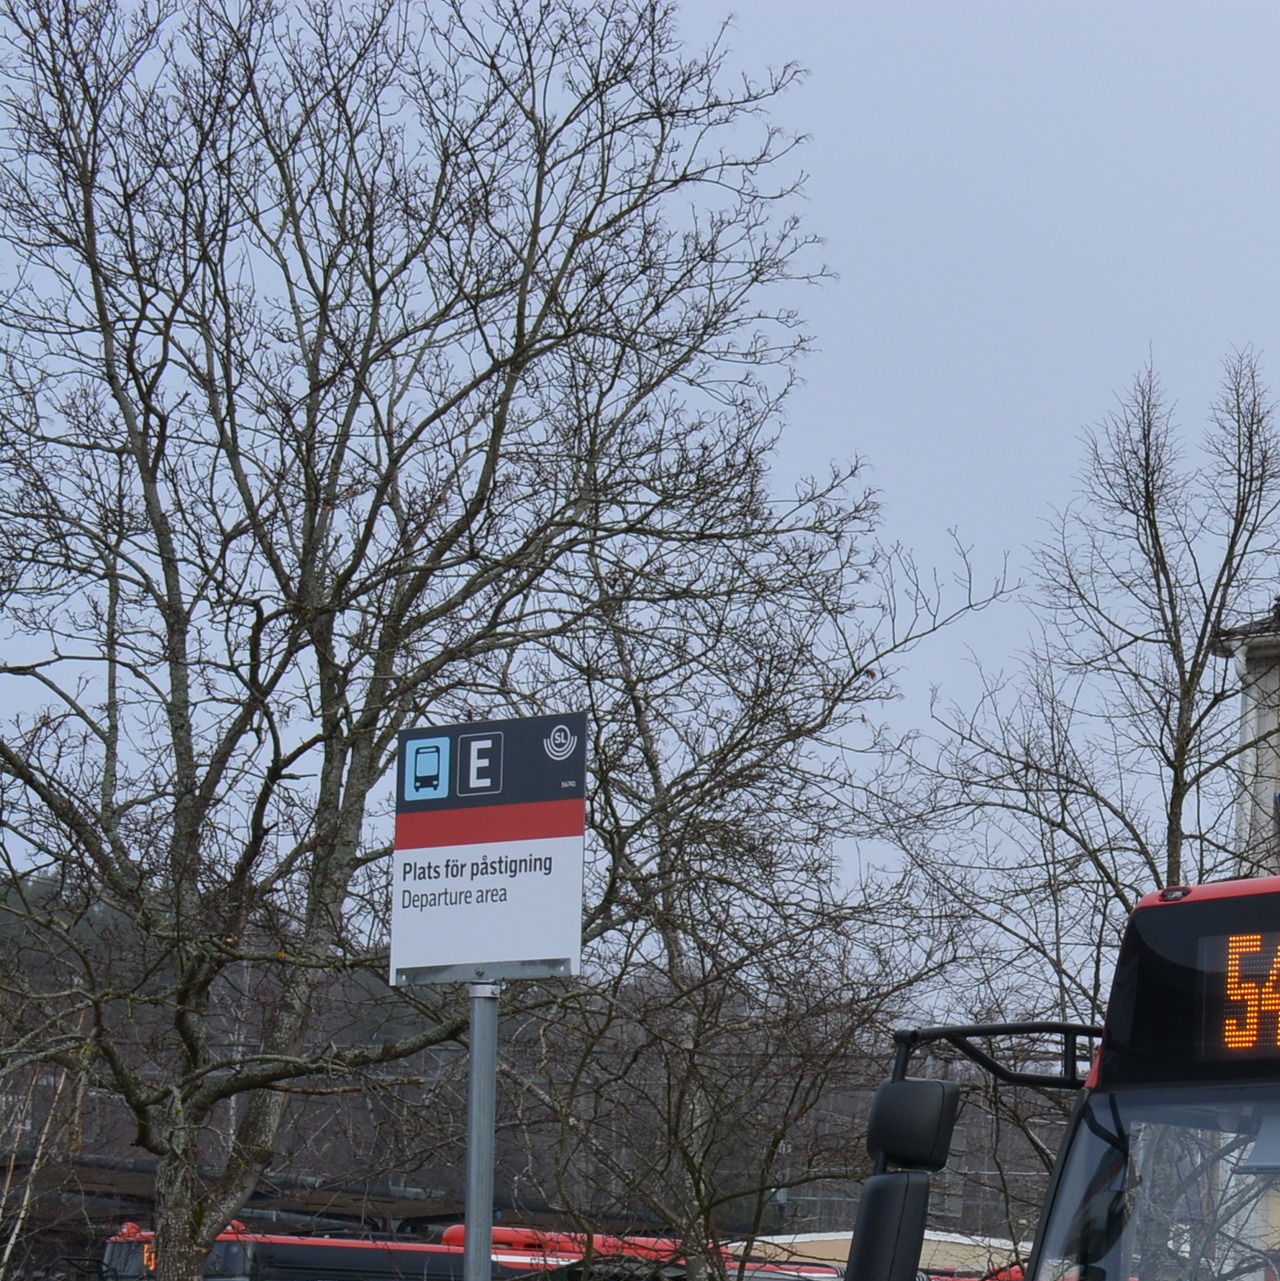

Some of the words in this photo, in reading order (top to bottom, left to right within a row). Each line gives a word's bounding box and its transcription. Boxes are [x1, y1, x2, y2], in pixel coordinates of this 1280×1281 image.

[554, 731, 566, 744] SL
[469, 739, 492, 788] E
[403, 861, 441, 882] Plats
[445, 857, 467, 878] för
[470, 854, 553, 881] påstigning
[401, 888, 473, 912] Departure
[476, 887, 508, 904] area
